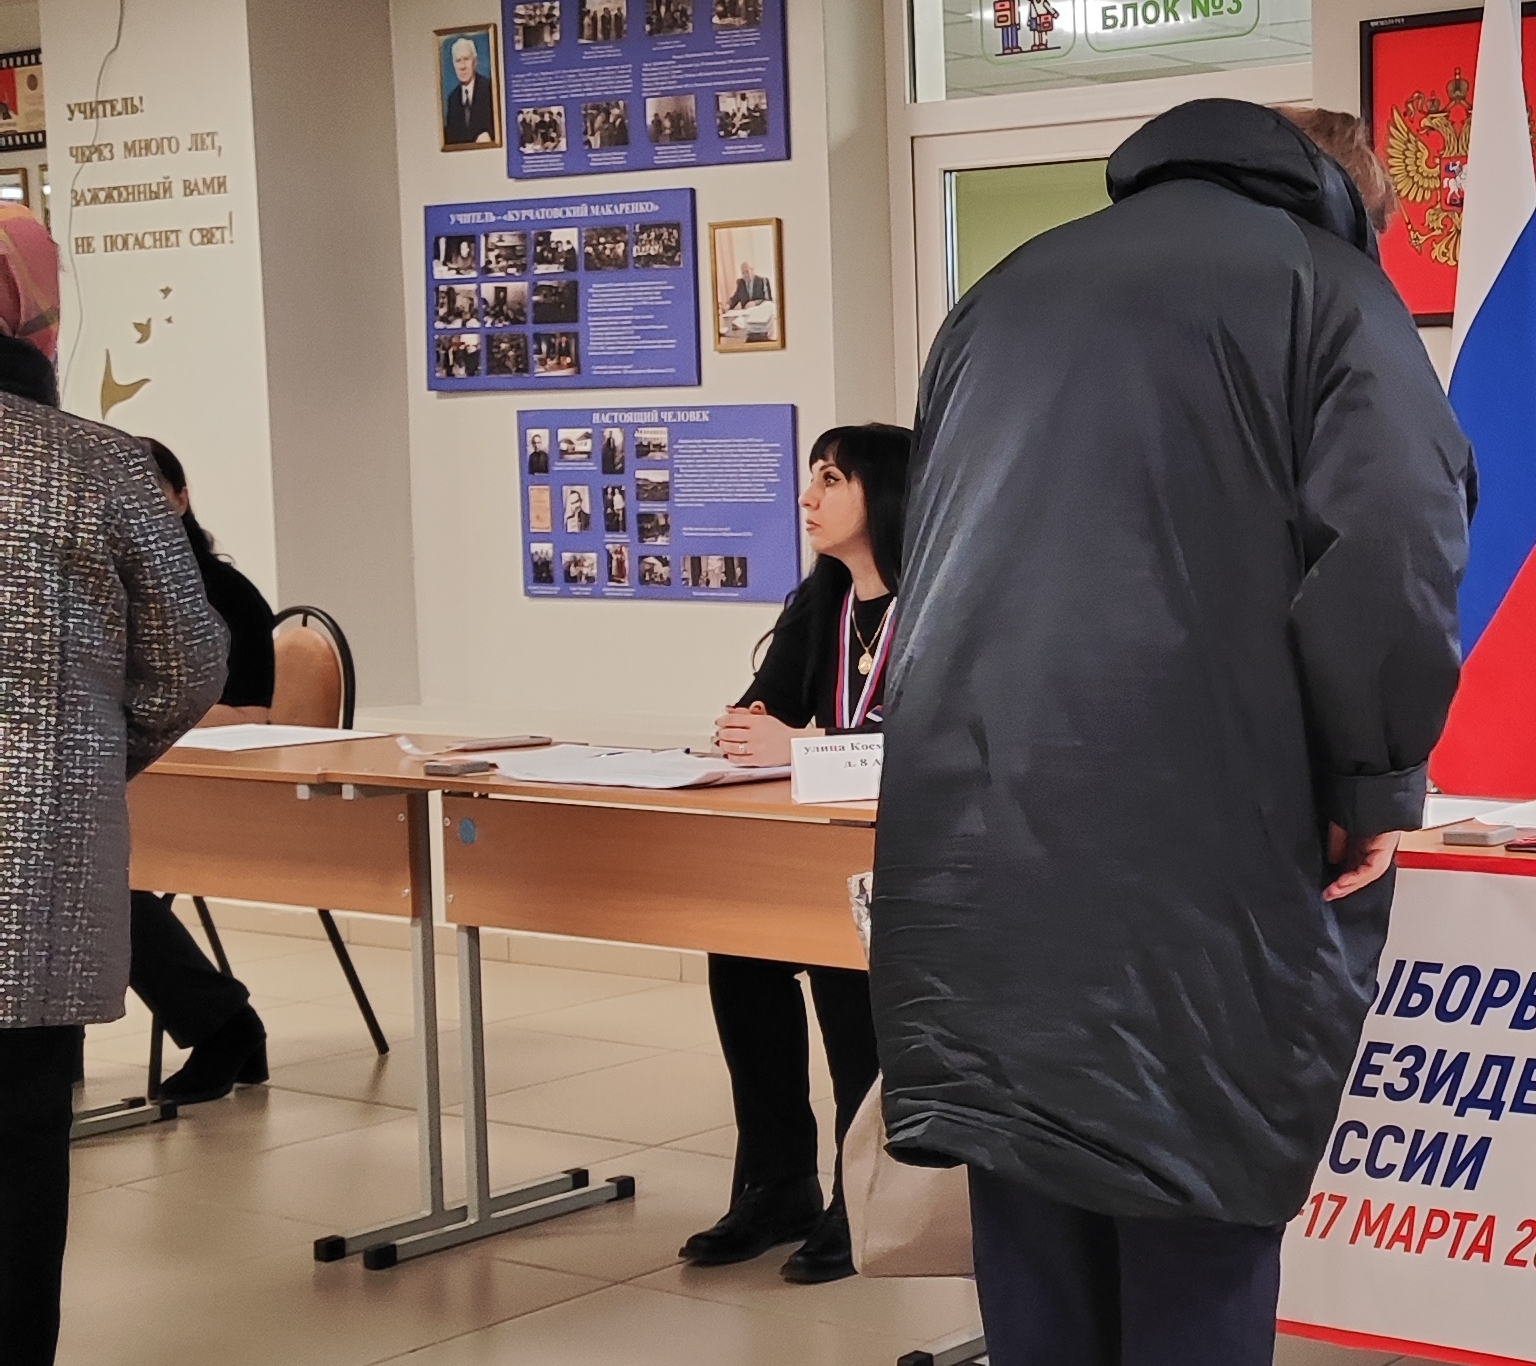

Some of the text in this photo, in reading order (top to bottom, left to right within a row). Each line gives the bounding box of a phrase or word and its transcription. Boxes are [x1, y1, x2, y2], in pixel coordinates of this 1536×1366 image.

[67, 95, 145, 121] УЧИТЕЛЬ!
[69, 131, 222, 164] ЧЕРЕЗ МНОГО ЛЕТ,
[71, 175, 229, 207] ЗАЖЖЕННЫЙ ВАМИ
[74, 210, 235, 255] НЕ ПОГАСНЕТ СВЕТ!
[592, 409, 709, 424] НАСТОЯЩИЙ ЧЕЛОВЕК
[804, 743, 846, 755] улица
[860, 758, 869, 767] 8
[1328, 1120, 1493, 1191] ССИИ
[1348, 1198, 1497, 1263] МАРТА
